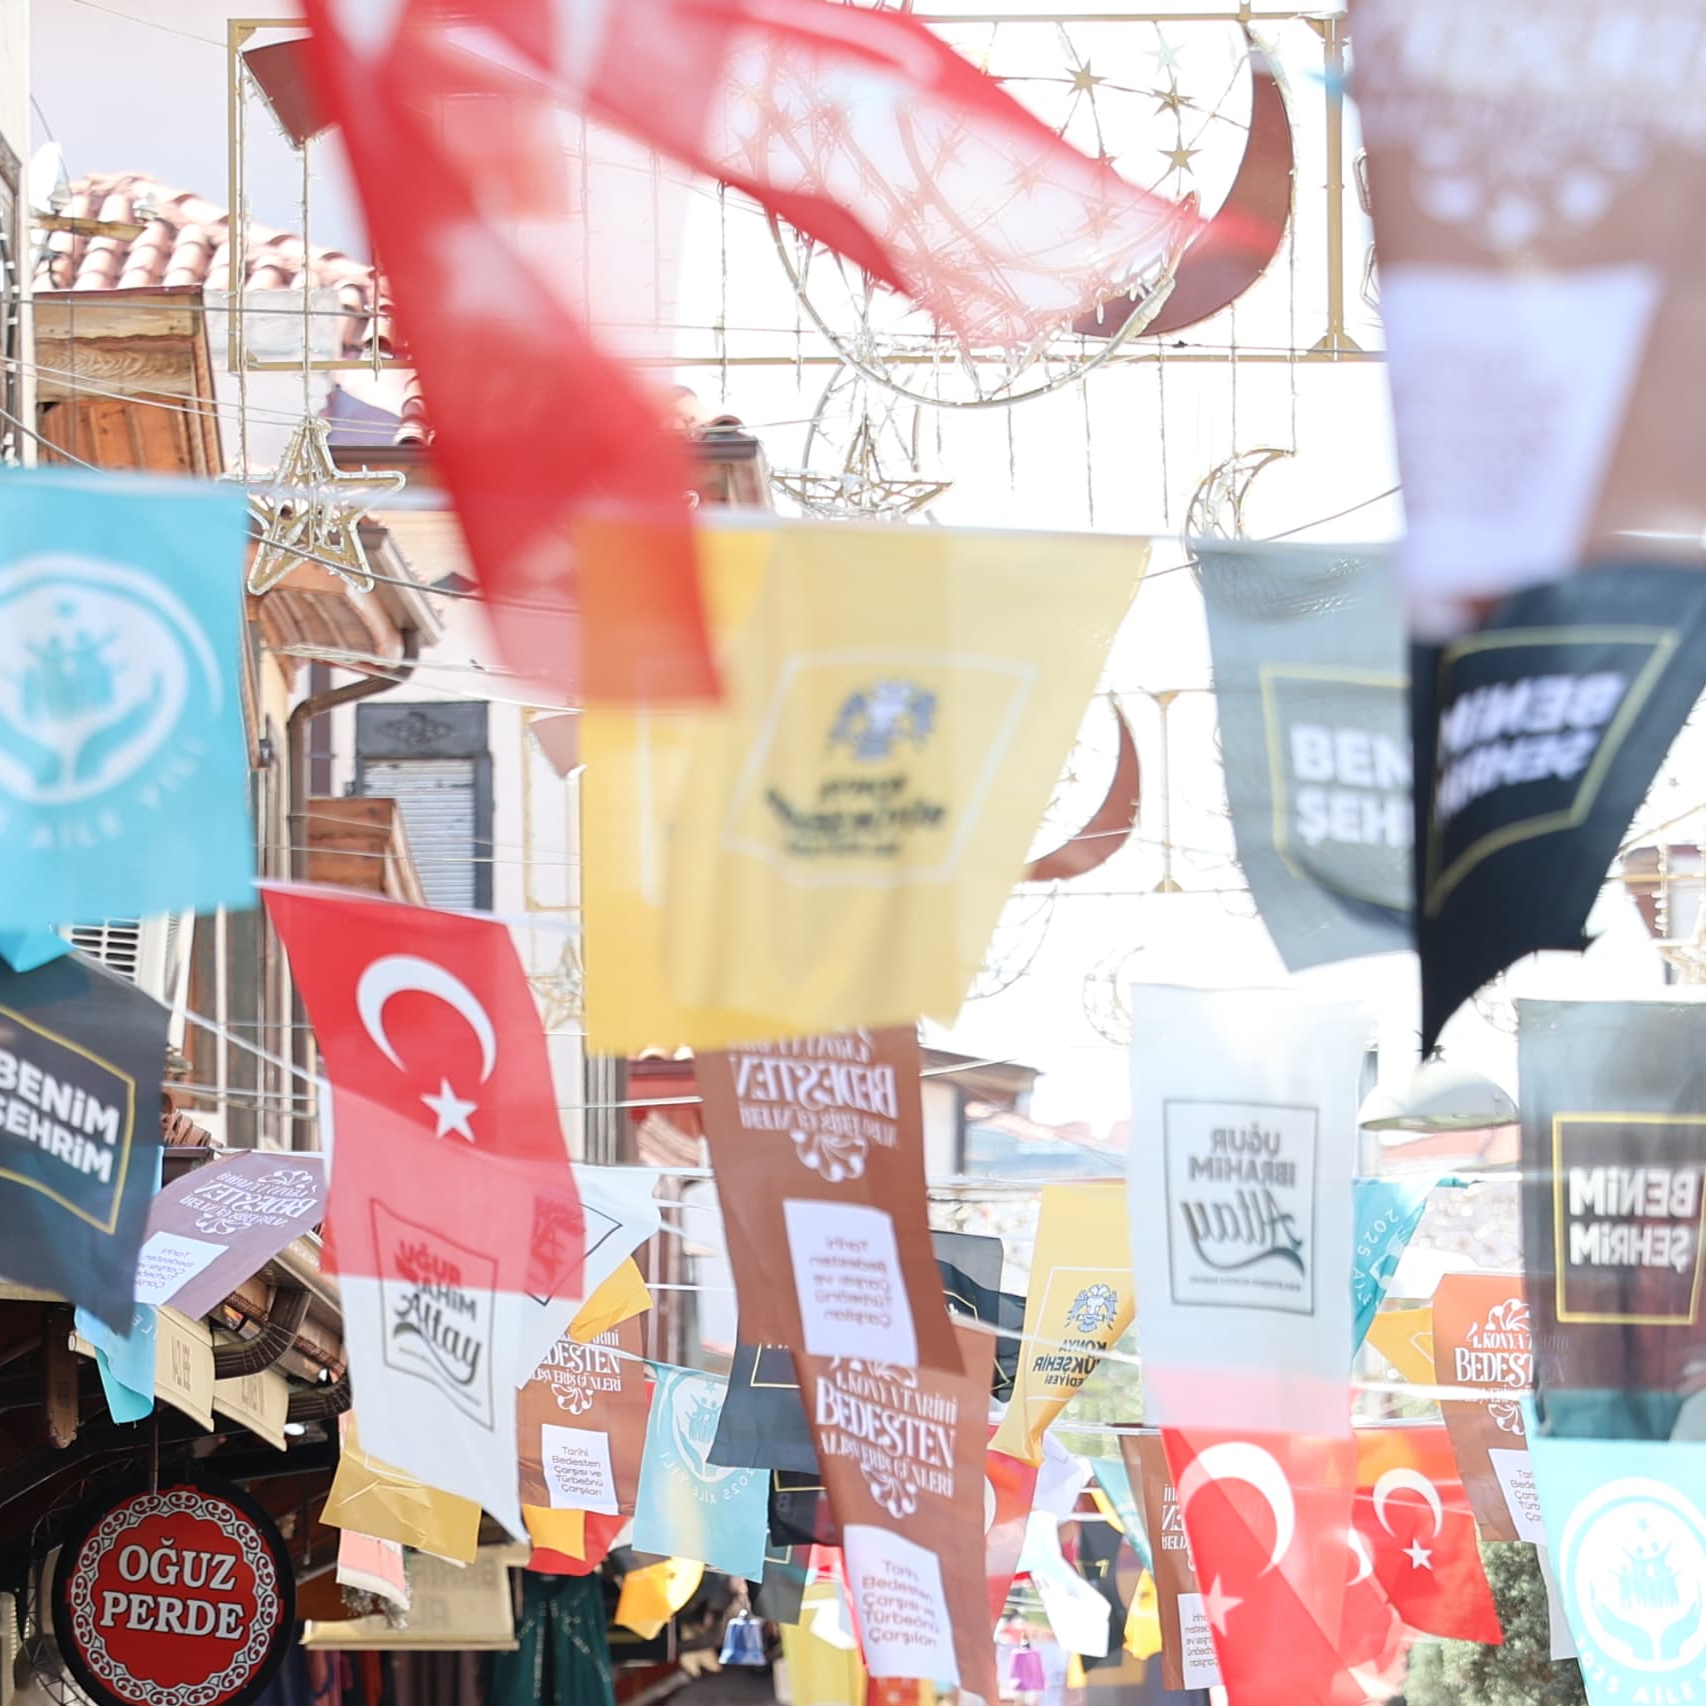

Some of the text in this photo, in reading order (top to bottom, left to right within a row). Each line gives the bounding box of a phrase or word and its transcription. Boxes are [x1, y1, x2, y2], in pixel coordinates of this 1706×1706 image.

[1290, 722, 1414, 790] BEN
[1295, 786, 1415, 848] ŞEH
[1357, 1208, 1399, 1256] 2025
[400, 1239, 462, 1288] UĞUR
[393, 1293, 482, 1386] Altay
[815, 1376, 956, 1469] BEDESTEN
[552, 1456, 601, 1468] Bedesten
[554, 1466, 602, 1477] Çarşısı ve
[561, 1446, 589, 1457] Tarihi
[555, 1475, 604, 1487] Türbeönü
[1517, 1501, 1540, 1511] Türb
[118, 1537, 238, 1591] OĞUZ
[100, 1590, 246, 1640] PERDE
[1577, 1636, 1619, 1694] 2025
[1632, 1679, 1696, 1706] AİLE
